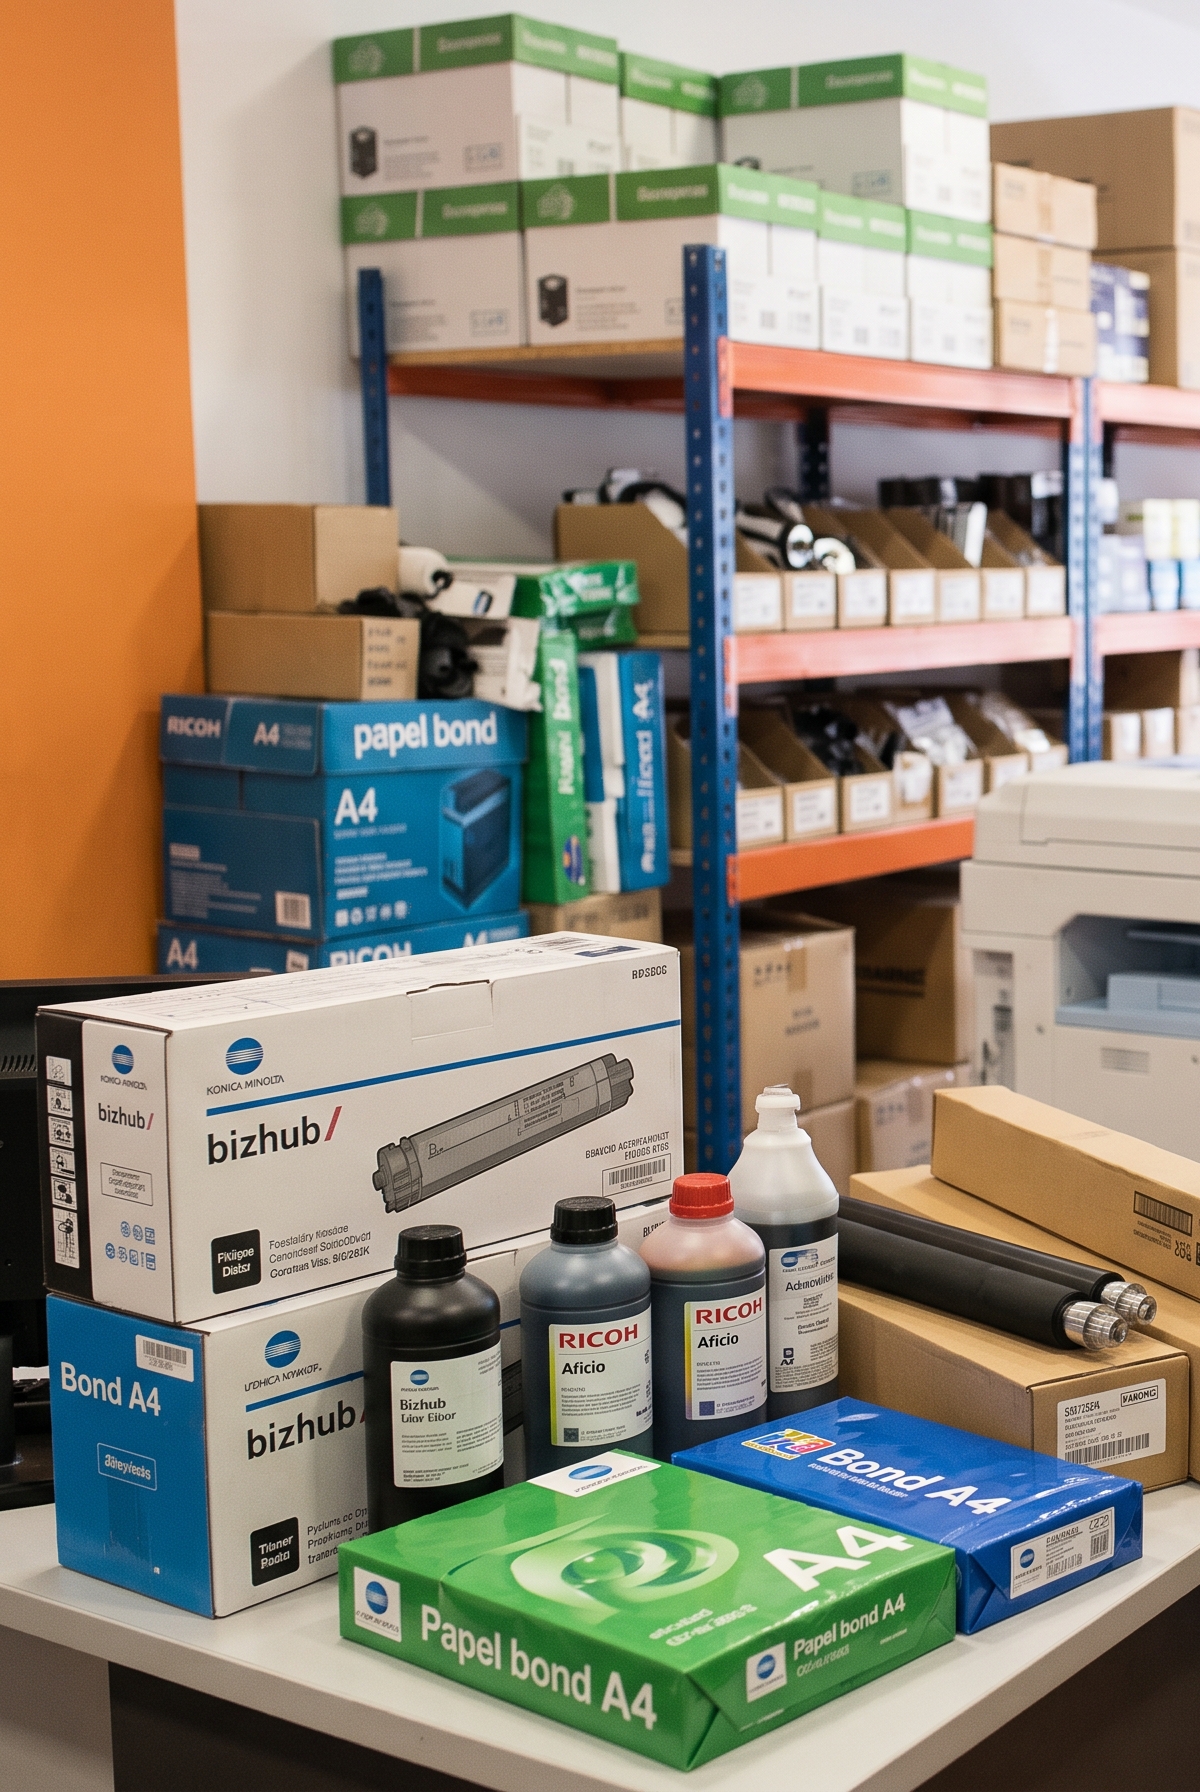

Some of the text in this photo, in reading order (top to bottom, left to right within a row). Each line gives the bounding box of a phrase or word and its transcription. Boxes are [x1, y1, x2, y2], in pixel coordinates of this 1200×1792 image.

[167, 715, 280, 746] RICOH A4
[354, 711, 497, 760] papel bond
[333, 787, 379, 826] A4
[166, 938, 199, 971] A4
[206, 1074, 285, 1096] KONICA MINOLTA
[695, 1297, 762, 1325] RICOH
[558, 1323, 638, 1349] RICOH
[697, 1332, 739, 1349] Aficio
[561, 1361, 606, 1375] Aficio
[60, 1361, 161, 1417] Bond A4
[400, 1397, 447, 1411] Bizhub
[817, 1448, 935, 1490] Bond
[925, 1485, 1012, 1515] A4
[763, 1525, 914, 1592] A4
[794, 1623, 836, 1661] Papel
[840, 1604, 879, 1639] bond
[882, 1593, 906, 1621] A4
[421, 1603, 657, 1731] Papel bond A4
